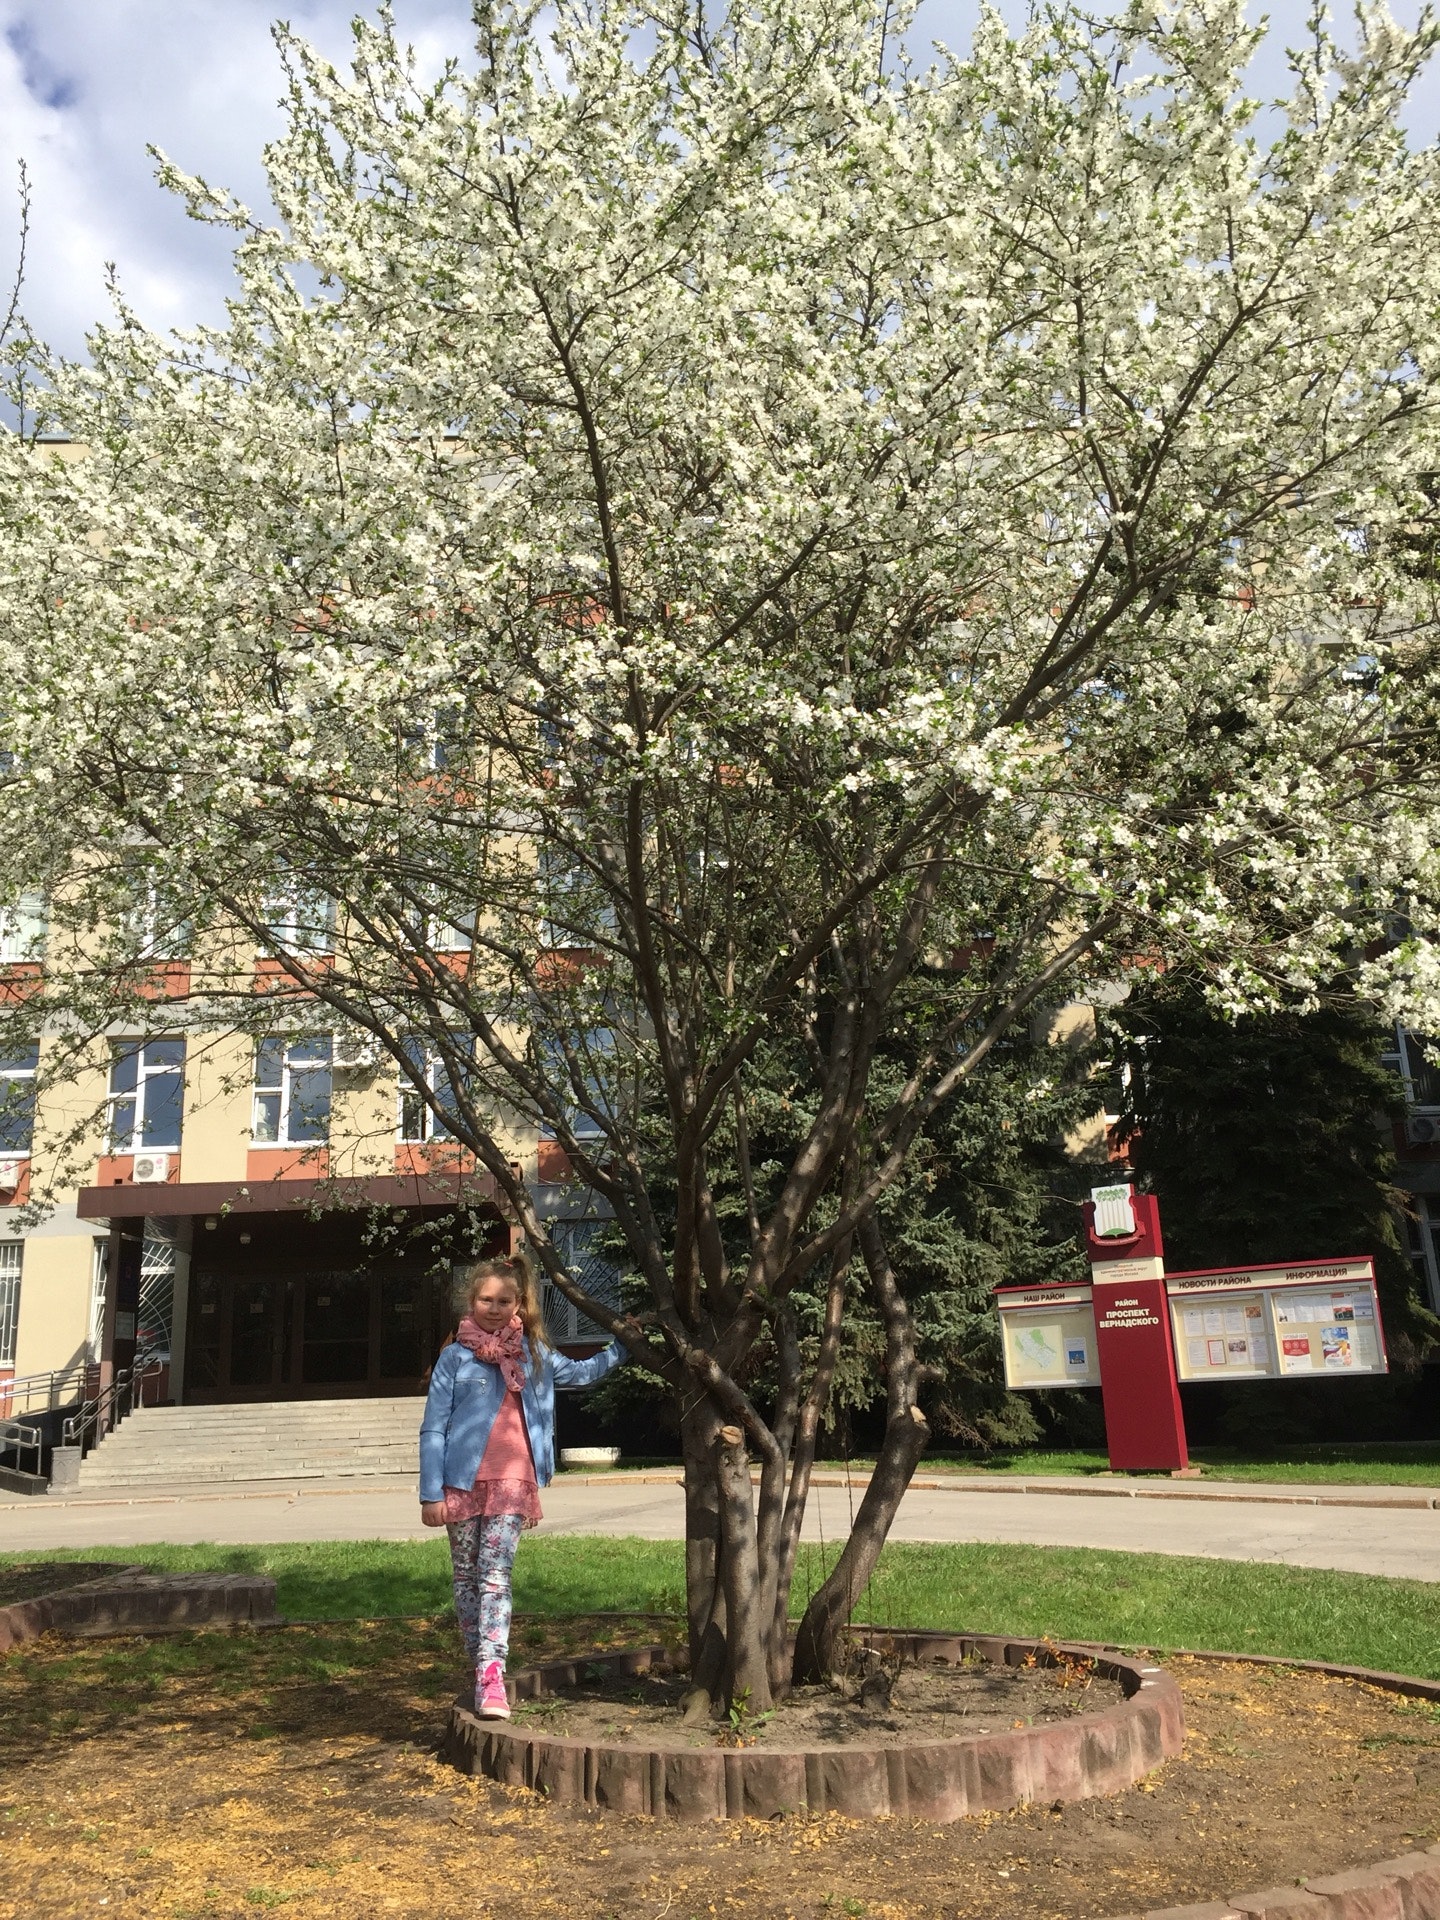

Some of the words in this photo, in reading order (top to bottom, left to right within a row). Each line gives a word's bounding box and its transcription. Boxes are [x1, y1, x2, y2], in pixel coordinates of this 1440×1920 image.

[1285, 1268, 1348, 1280] ИНФОРМАЦИЯ
[1178, 1278, 1217, 1289] НОВОСТИ
[1218, 1275, 1252, 1286] РАЙОНА
[1023, 1295, 1040, 1303] НАШ
[1040, 1292, 1066, 1301] РАЙОН
[1114, 1298, 1139, 1307] РАЙОН
[1106, 1308, 1150, 1319] ПРОСПЕКТ
[1099, 1317, 1159, 1328] ВЕРНАДСКОГО
